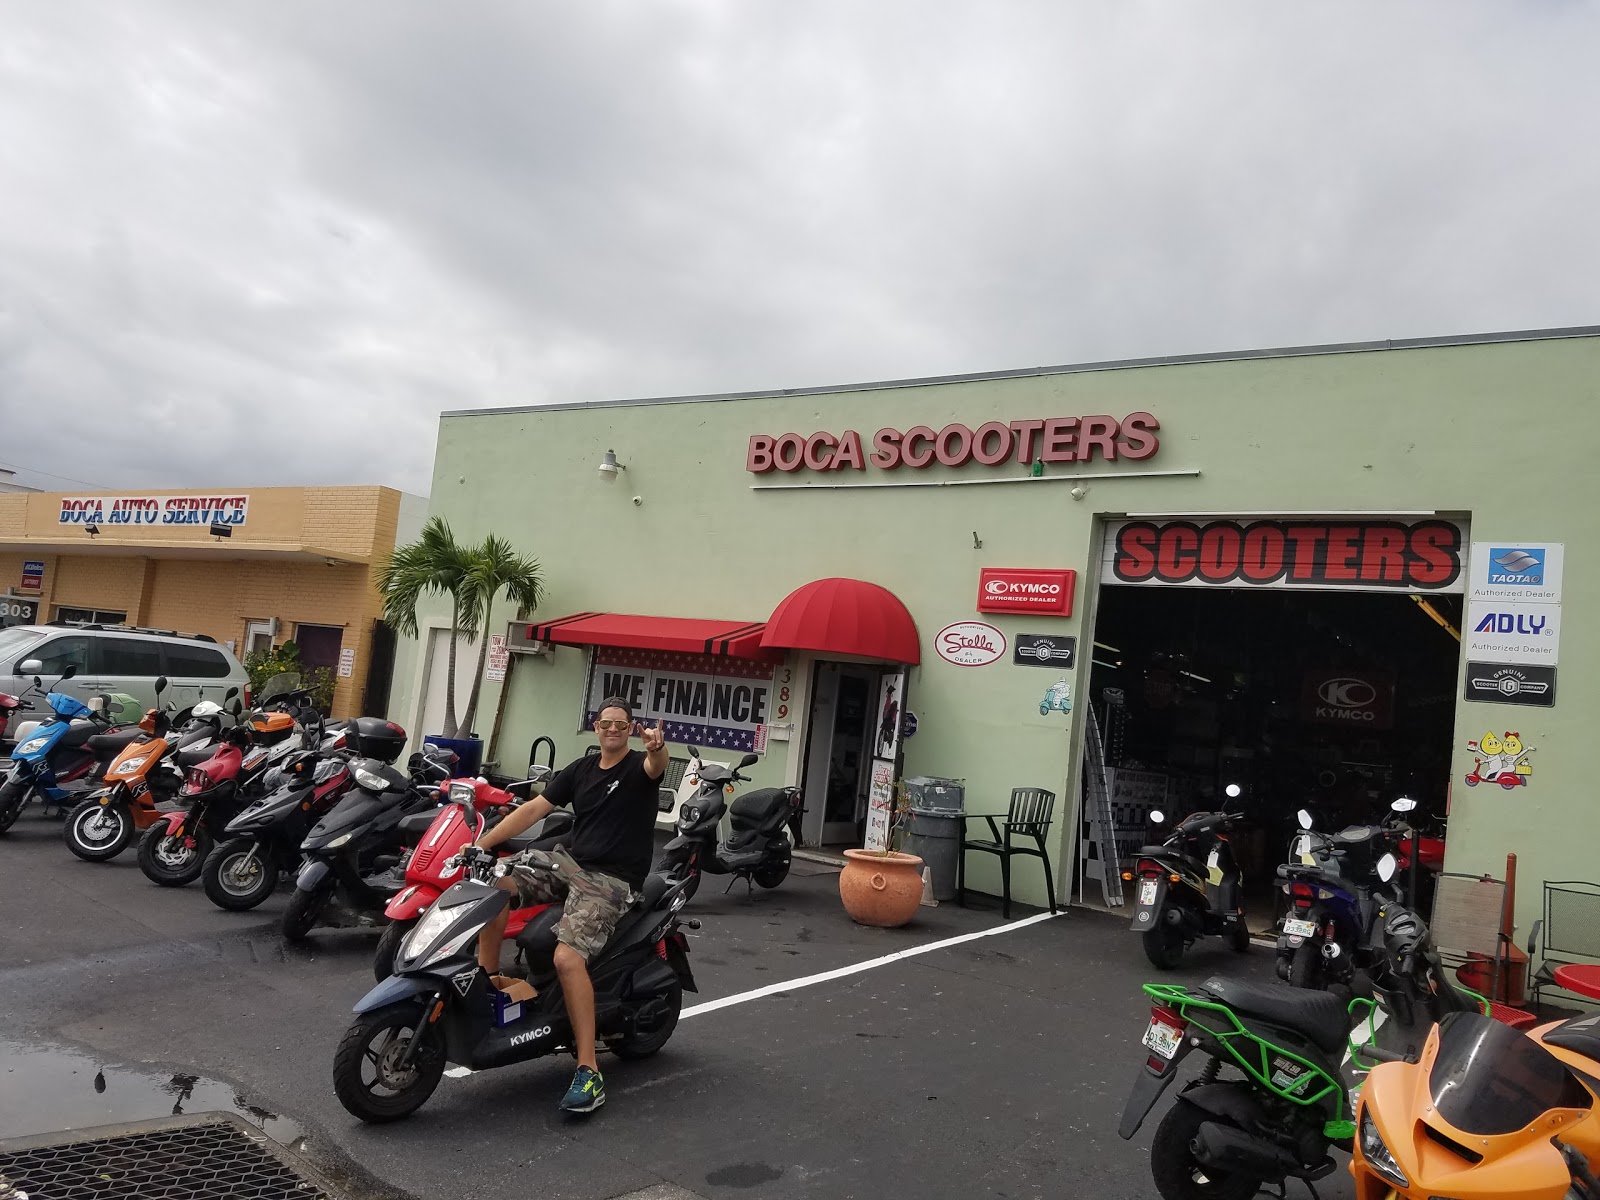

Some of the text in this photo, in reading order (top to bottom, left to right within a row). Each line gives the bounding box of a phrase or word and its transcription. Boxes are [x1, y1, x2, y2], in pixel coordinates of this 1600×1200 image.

[746, 411, 1160, 473] BOCA SCOOTERS
[59, 497, 246, 524] BOCA AUTO SERVICE
[1114, 521, 1461, 587] SCOOTERS
[1491, 574, 1541, 583] TAOTAO
[1009, 583, 1060, 594] KYMCO
[1474, 589, 1555, 598] Authorized Dealer
[0, 602, 32, 619] 303
[1473, 613, 1546, 635] ADLY
[943, 633, 997, 654] Stella
[1033, 639, 1056, 649] GENUINE
[1471, 643, 1553, 654] Authorized Dealer
[1493, 669, 1527, 681] GENUINE
[603, 672, 767, 724] WE FINANCE
[1315, 707, 1375, 721] KYMCO
[510, 1025, 551, 1046] KYMCO
